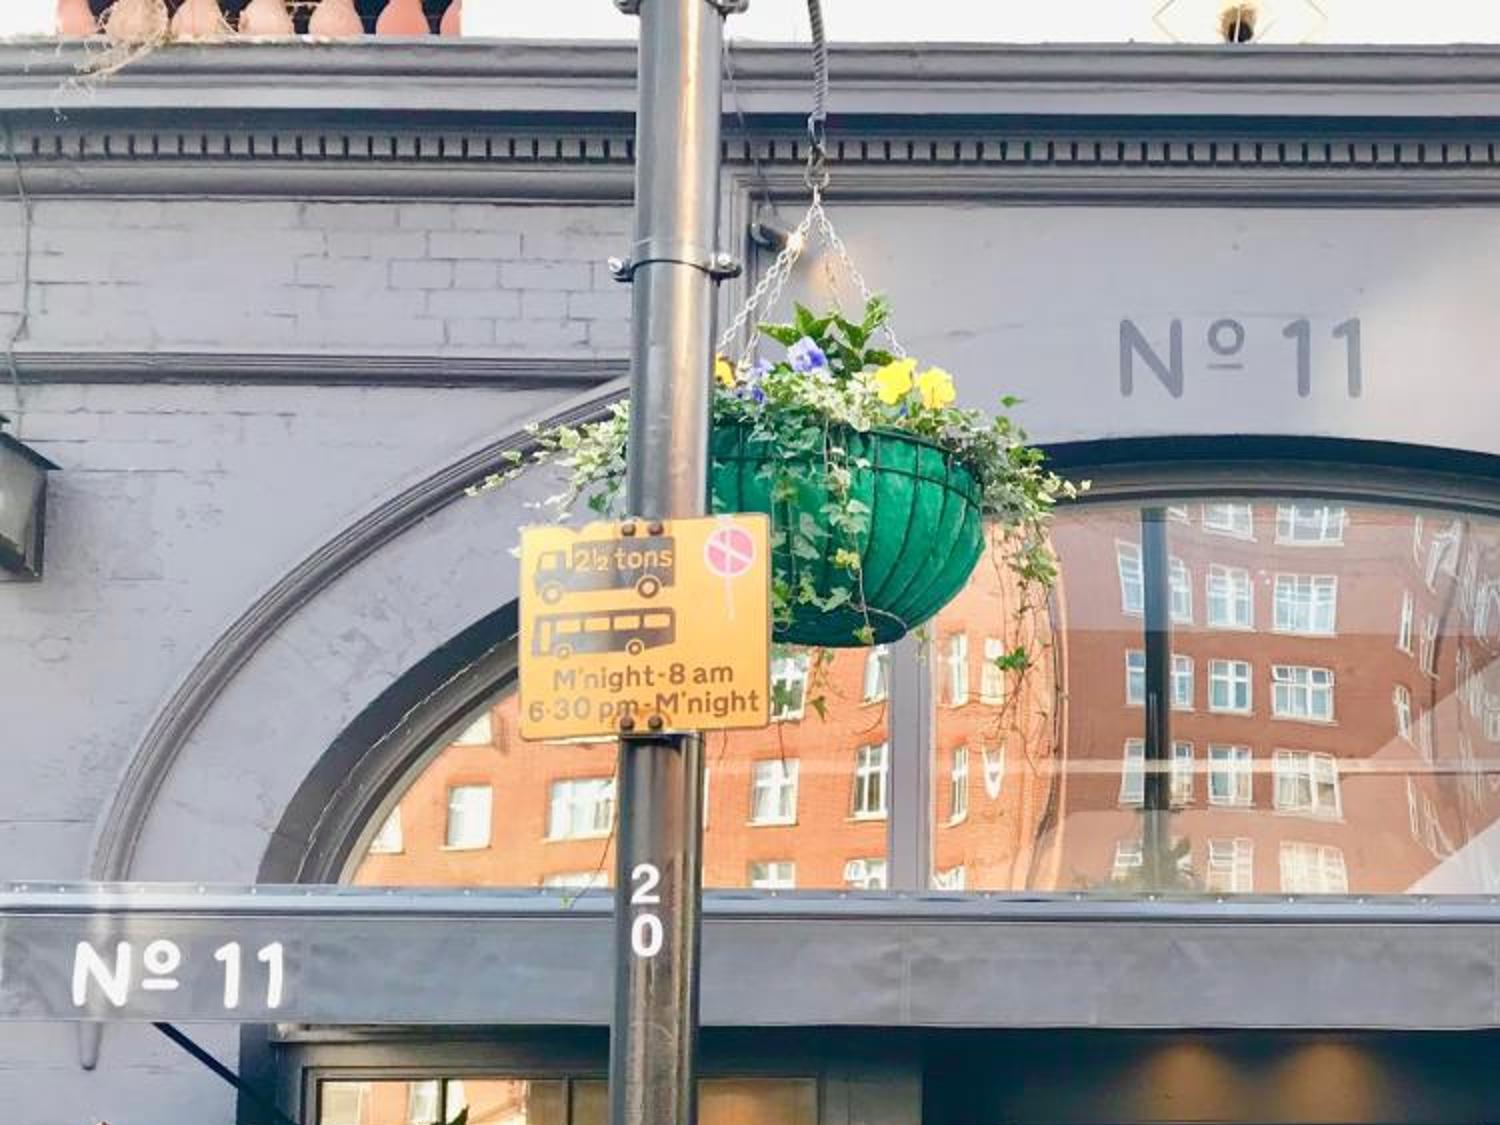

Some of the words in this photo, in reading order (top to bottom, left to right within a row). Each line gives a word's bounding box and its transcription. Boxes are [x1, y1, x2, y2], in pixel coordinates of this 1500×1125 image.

[1282, 317, 1362, 398] 11
[616, 547, 673, 569] tons
[693, 665, 734, 685] am
[213, 941, 285, 1009] 11
